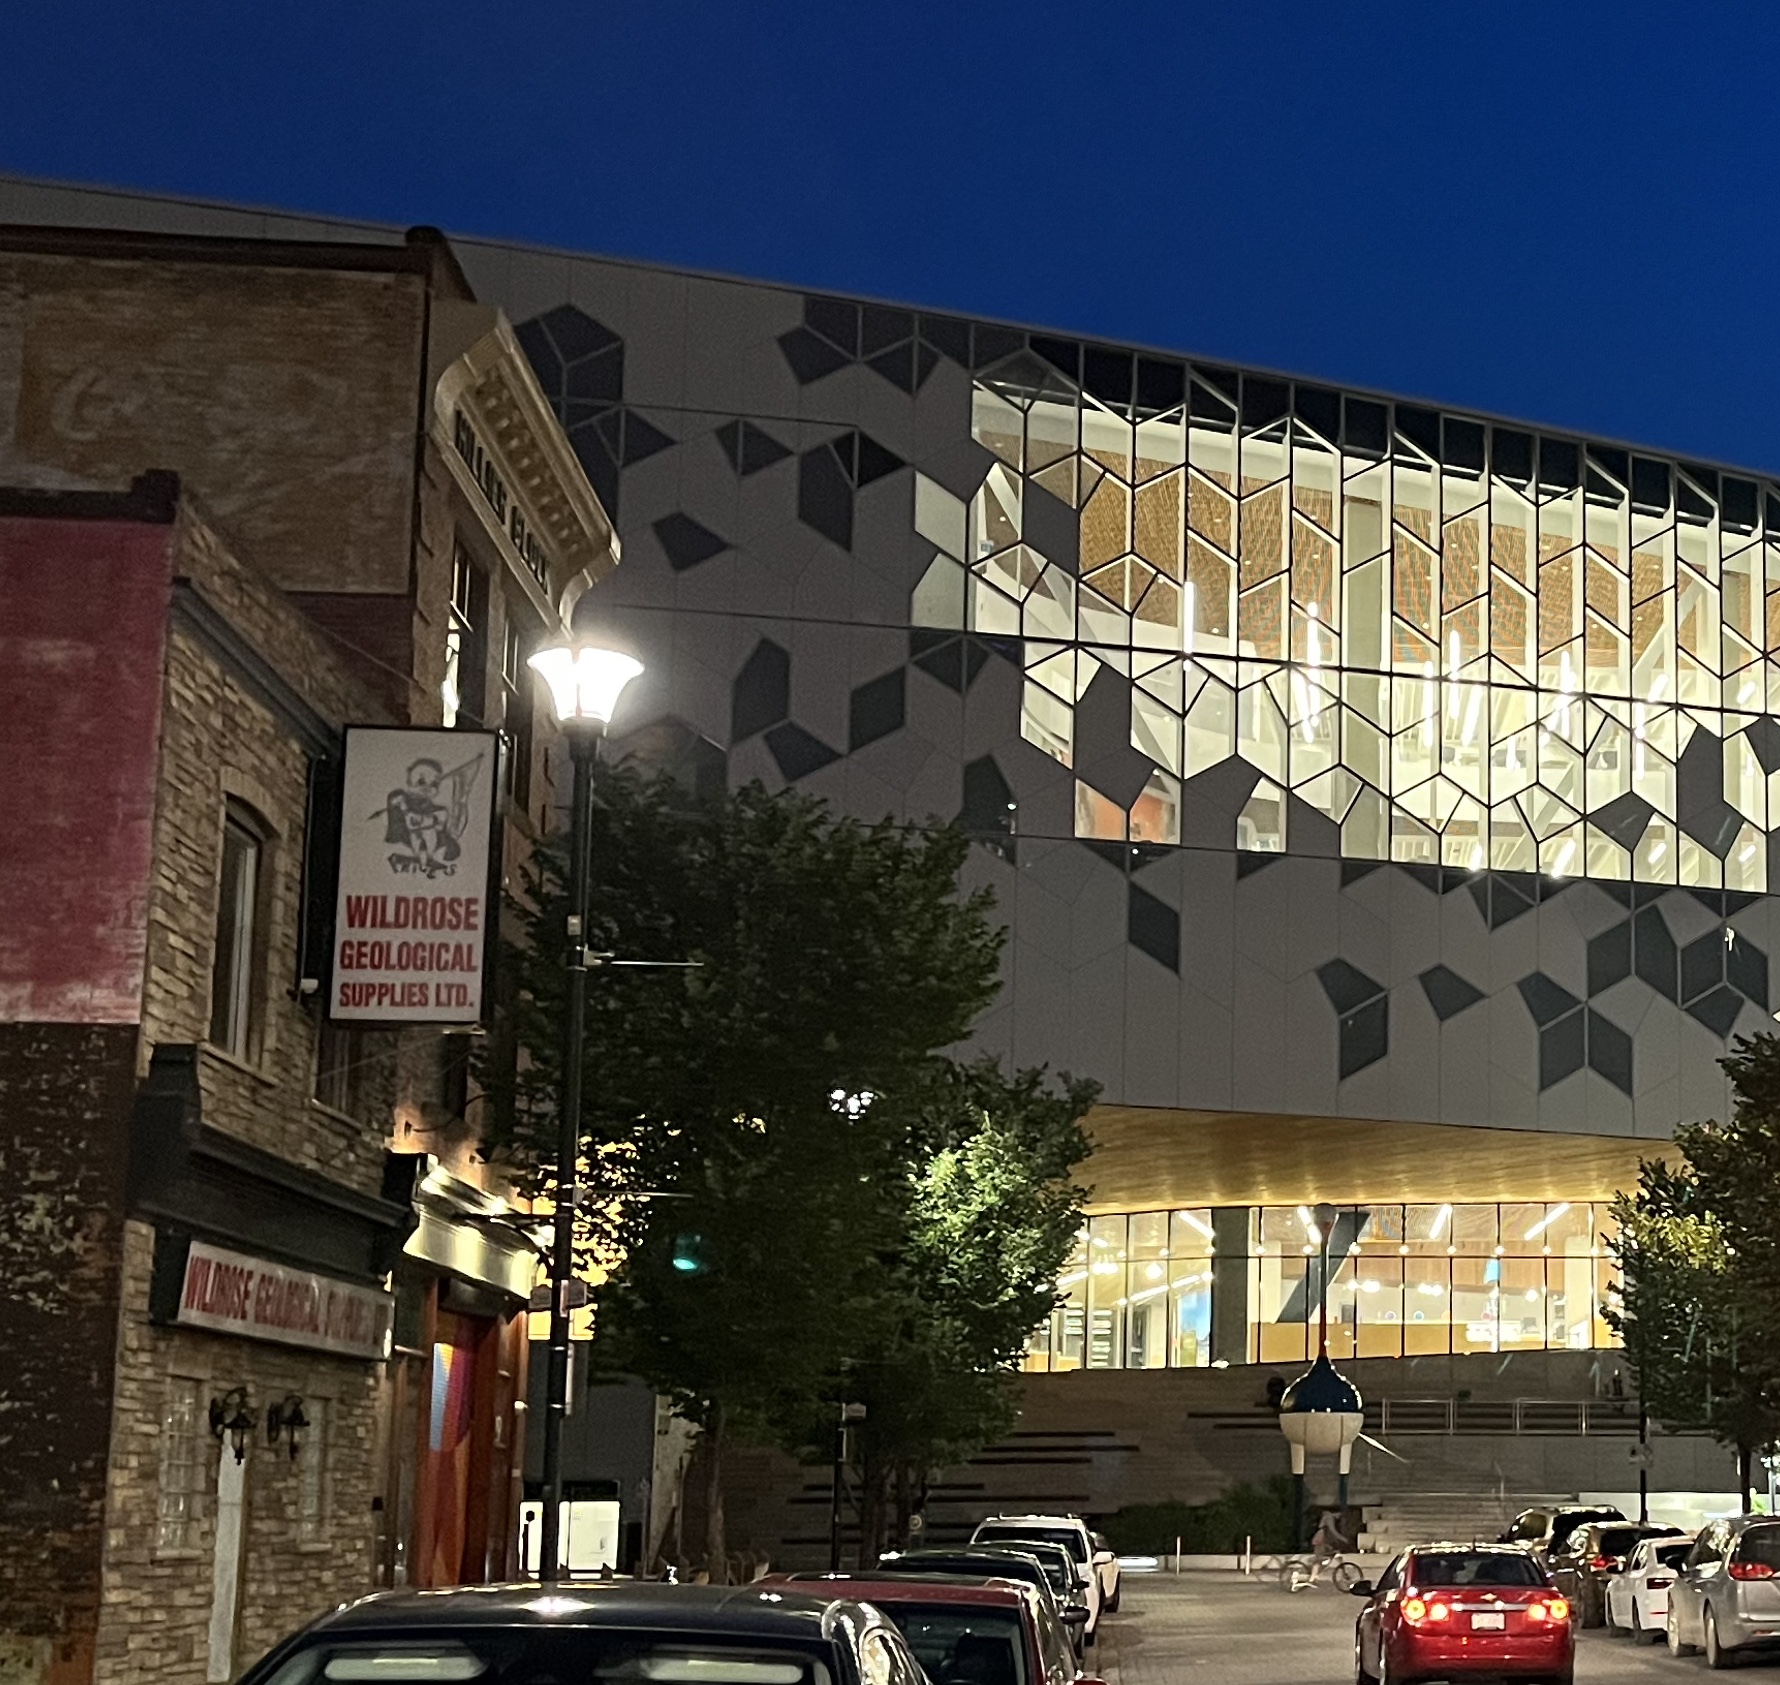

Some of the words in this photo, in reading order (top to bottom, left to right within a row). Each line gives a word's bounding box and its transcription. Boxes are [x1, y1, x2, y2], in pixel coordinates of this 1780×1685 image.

[346, 895, 479, 931] WILDROSE
[339, 941, 478, 973] GEOLOGICAL
[339, 982, 429, 1008] SUPPLIES
[435, 983, 475, 1009] LTD.
[184, 1256, 254, 1321] WILDROSE
